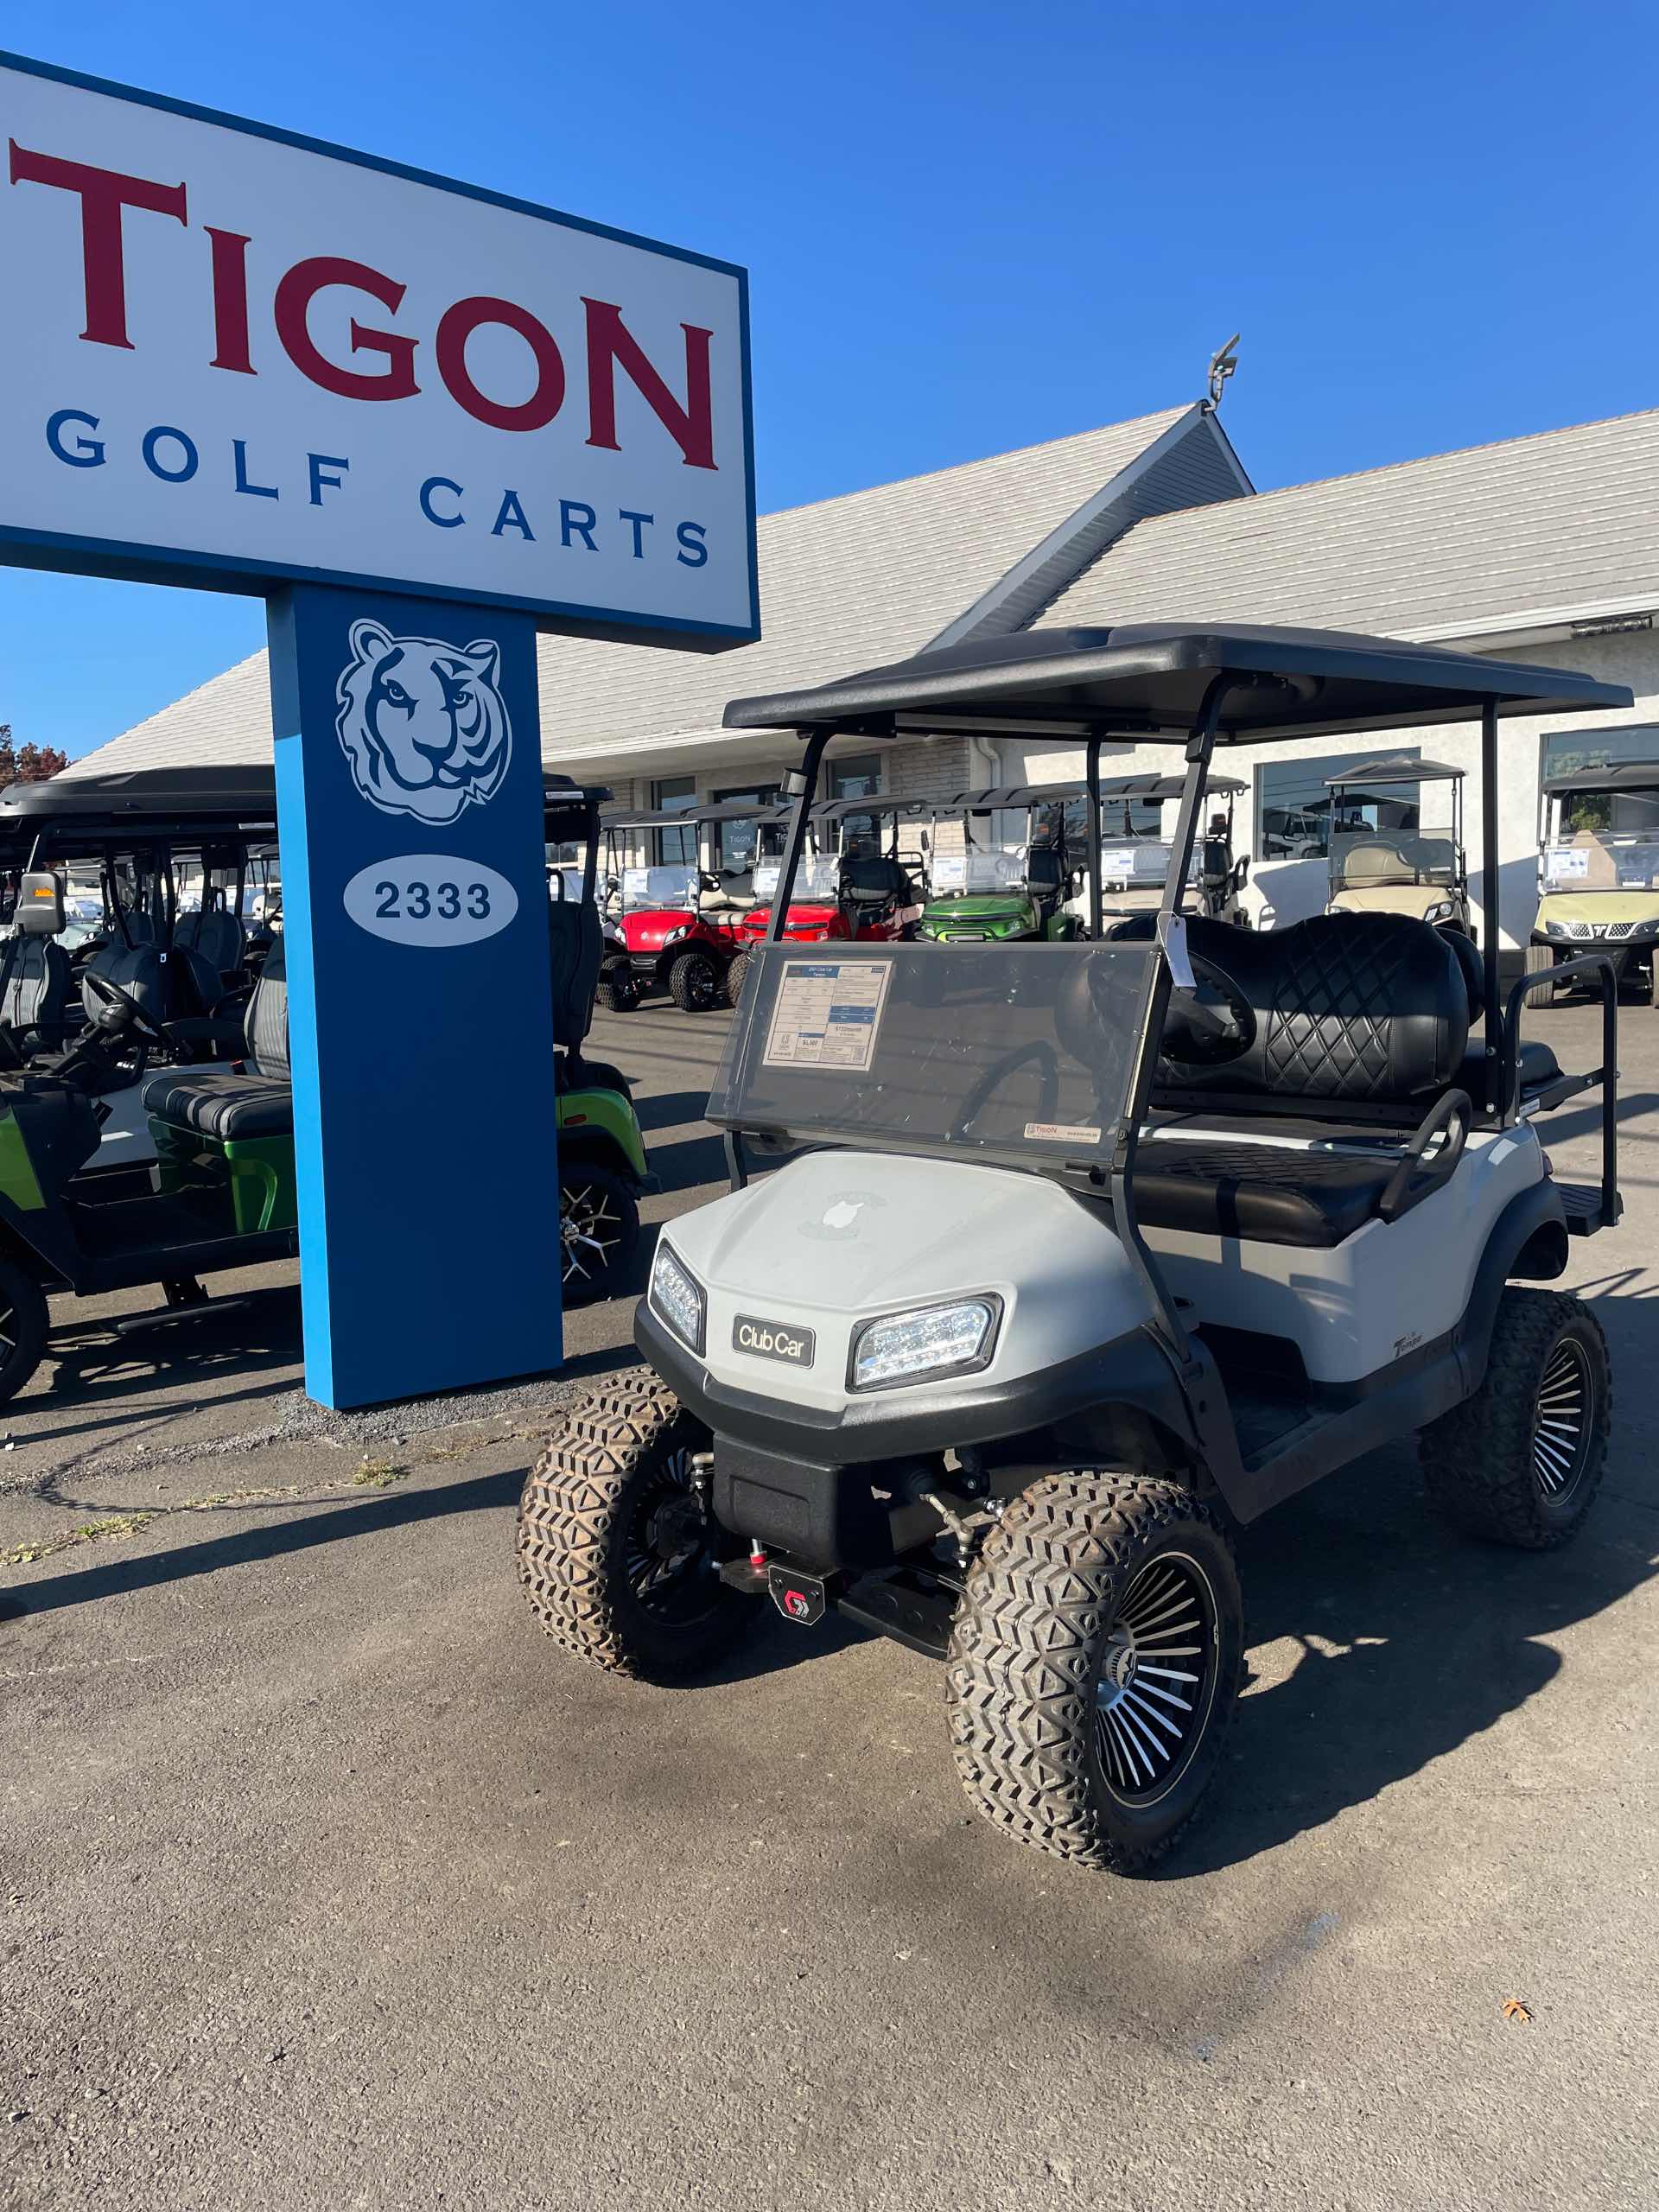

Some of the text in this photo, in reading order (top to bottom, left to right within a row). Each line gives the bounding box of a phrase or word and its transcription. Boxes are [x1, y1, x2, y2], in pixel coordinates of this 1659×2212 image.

[9, 138, 718, 471] TIGON
[46, 409, 709, 568] GOLF CARTS
[375, 881, 491, 919] 2333
[739, 1324, 805, 1359] Club Car
